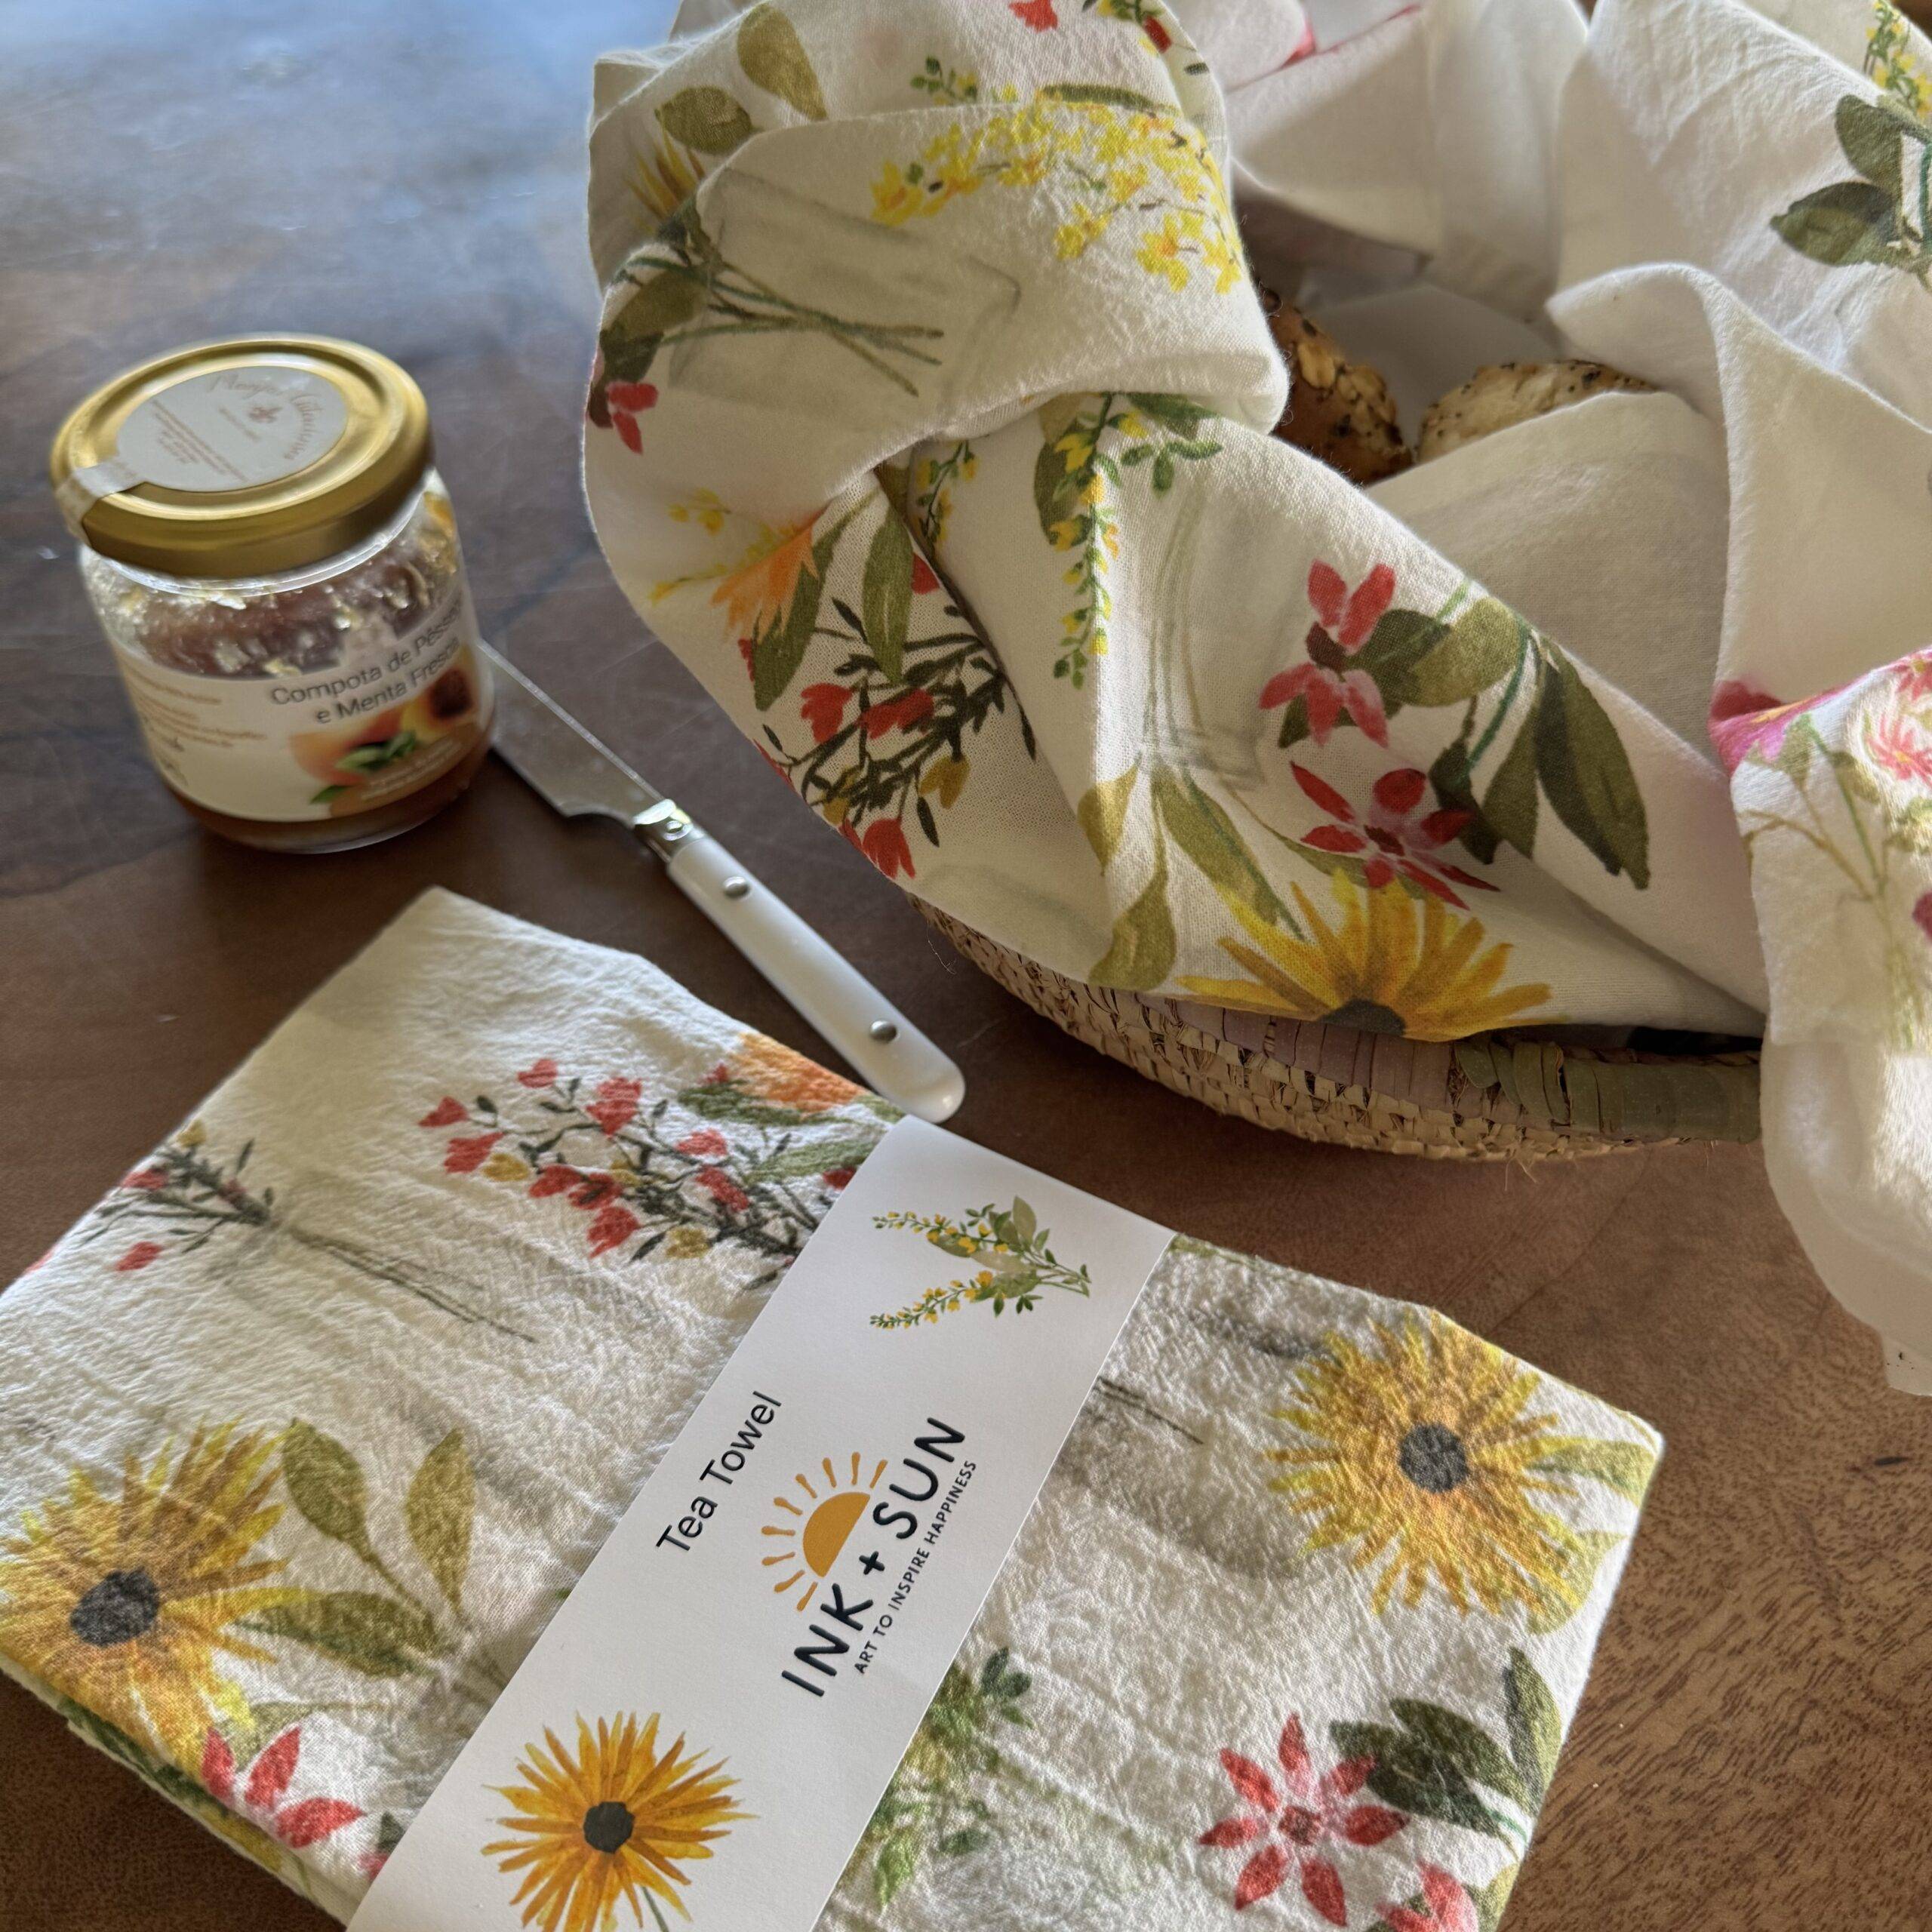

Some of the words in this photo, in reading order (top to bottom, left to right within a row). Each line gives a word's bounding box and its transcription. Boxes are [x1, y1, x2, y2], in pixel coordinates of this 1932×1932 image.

[271, 663, 383, 705] Compota
[387, 648, 411, 672] de
[315, 709, 331, 724] e
[337, 679, 408, 719] Menta
[656, 1496, 718, 1551] Tea
[699, 1390, 782, 1484] Towel
[781, 1583, 873, 1697] INK
[859, 1551, 885, 1575] +
[872, 1417, 966, 1540] SUN
[854, 1641, 878, 1675] ART
[872, 1614, 893, 1638] TO
[888, 1547, 930, 1611] INSPIRE
[924, 1460, 977, 1545] HAPPINESS
